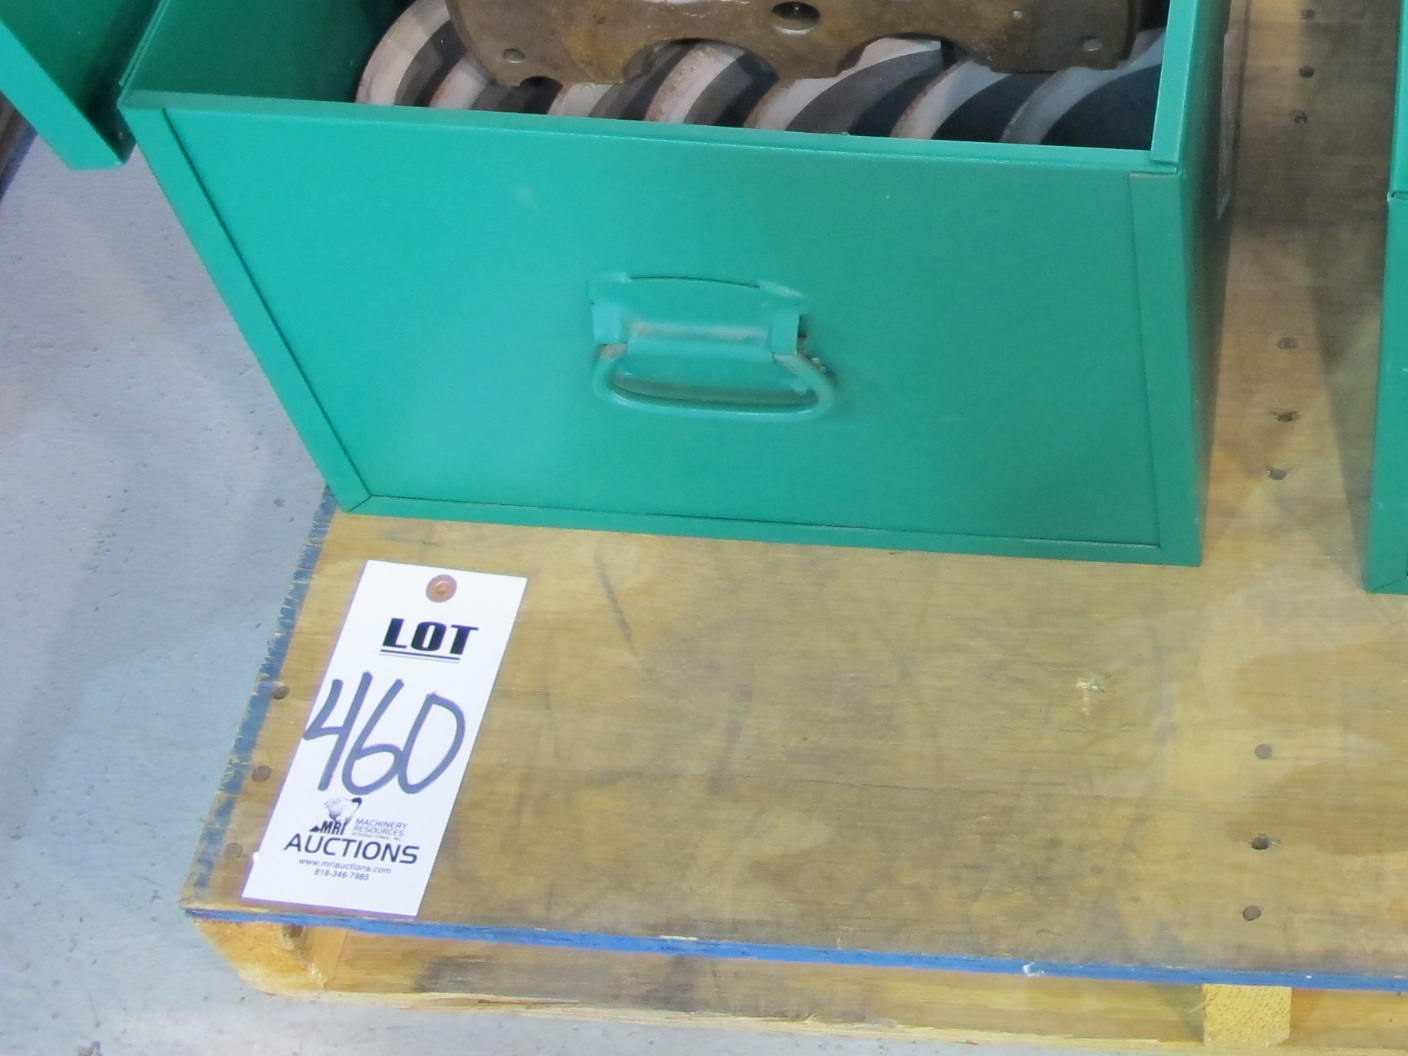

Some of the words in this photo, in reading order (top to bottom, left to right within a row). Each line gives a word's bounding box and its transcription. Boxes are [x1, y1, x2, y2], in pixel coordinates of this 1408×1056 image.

[381, 617, 479, 655] LOT
[302, 671, 466, 795] 460
[319, 819, 349, 836] MRI
[352, 824, 406, 837] RESOURCES
[355, 817, 408, 830] MACHINERY
[283, 833, 420, 864] AUCTIONS
